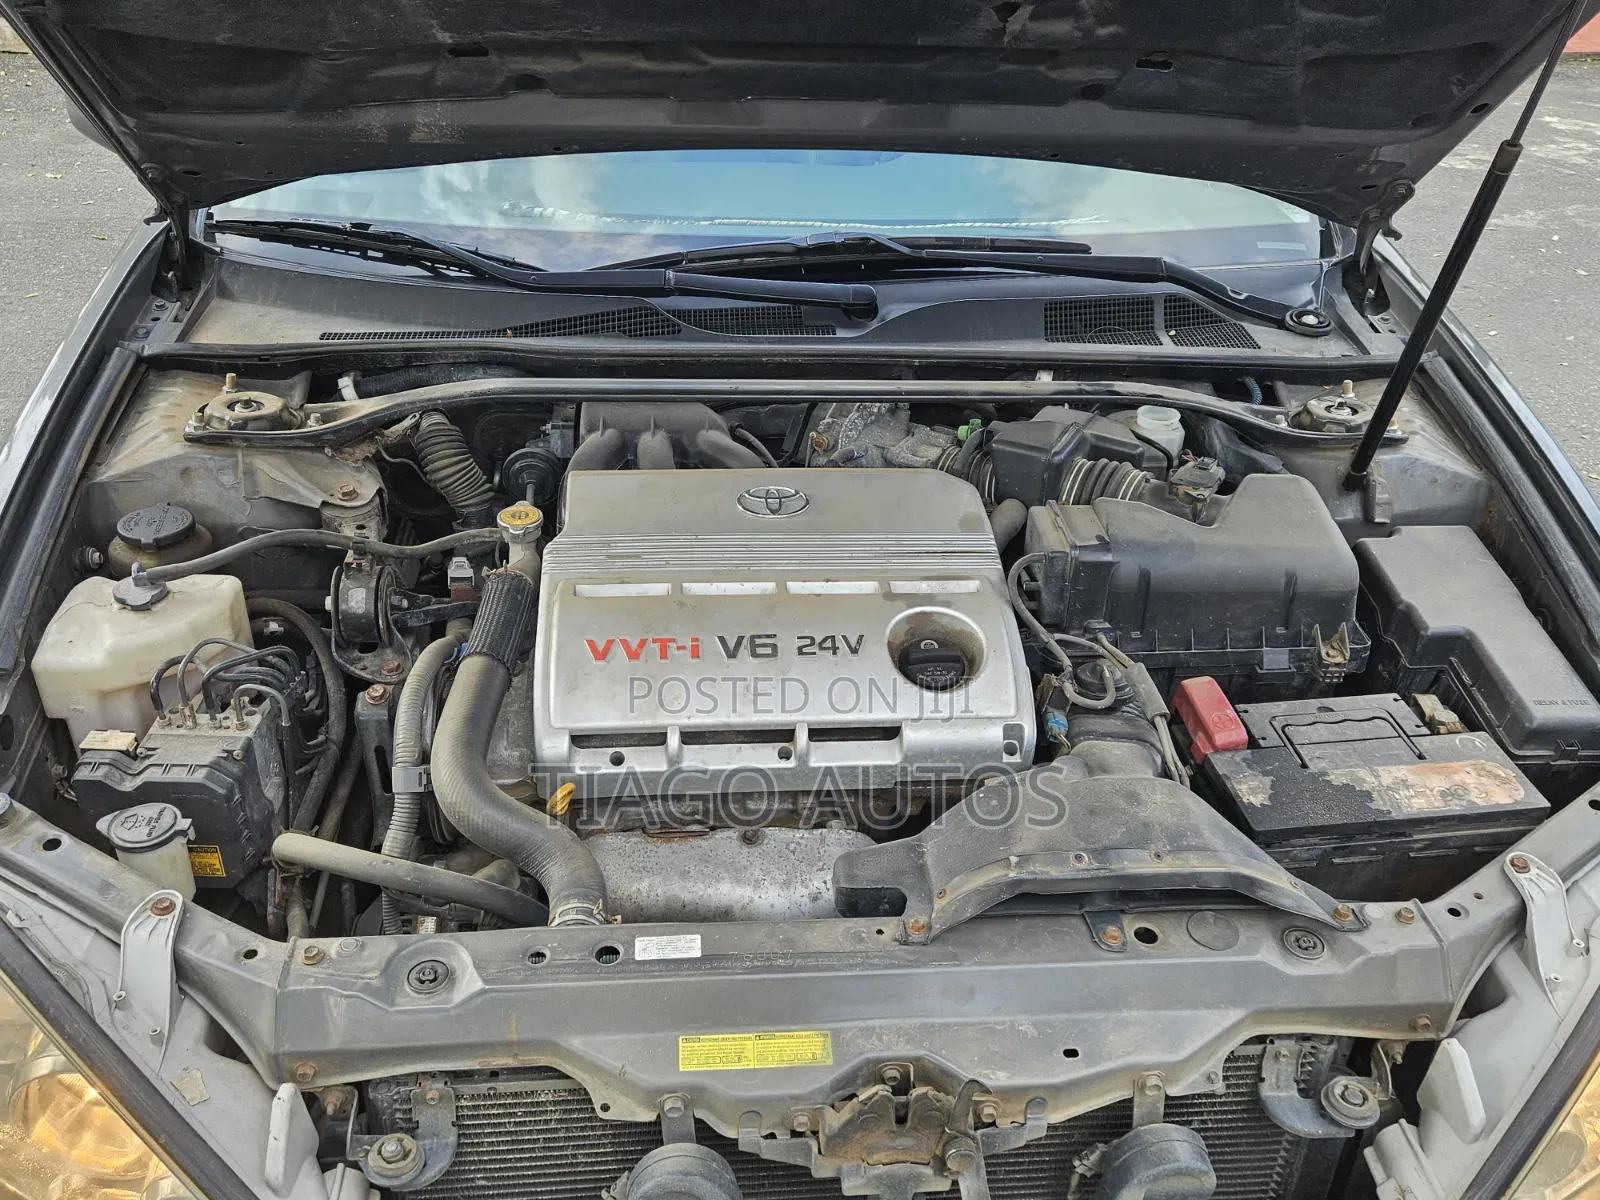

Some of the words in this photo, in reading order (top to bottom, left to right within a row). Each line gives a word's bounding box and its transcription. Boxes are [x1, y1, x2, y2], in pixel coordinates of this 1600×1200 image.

[585, 636, 701, 662] VVT-i
[715, 633, 780, 661] V6
[796, 634, 865, 658] 24V
